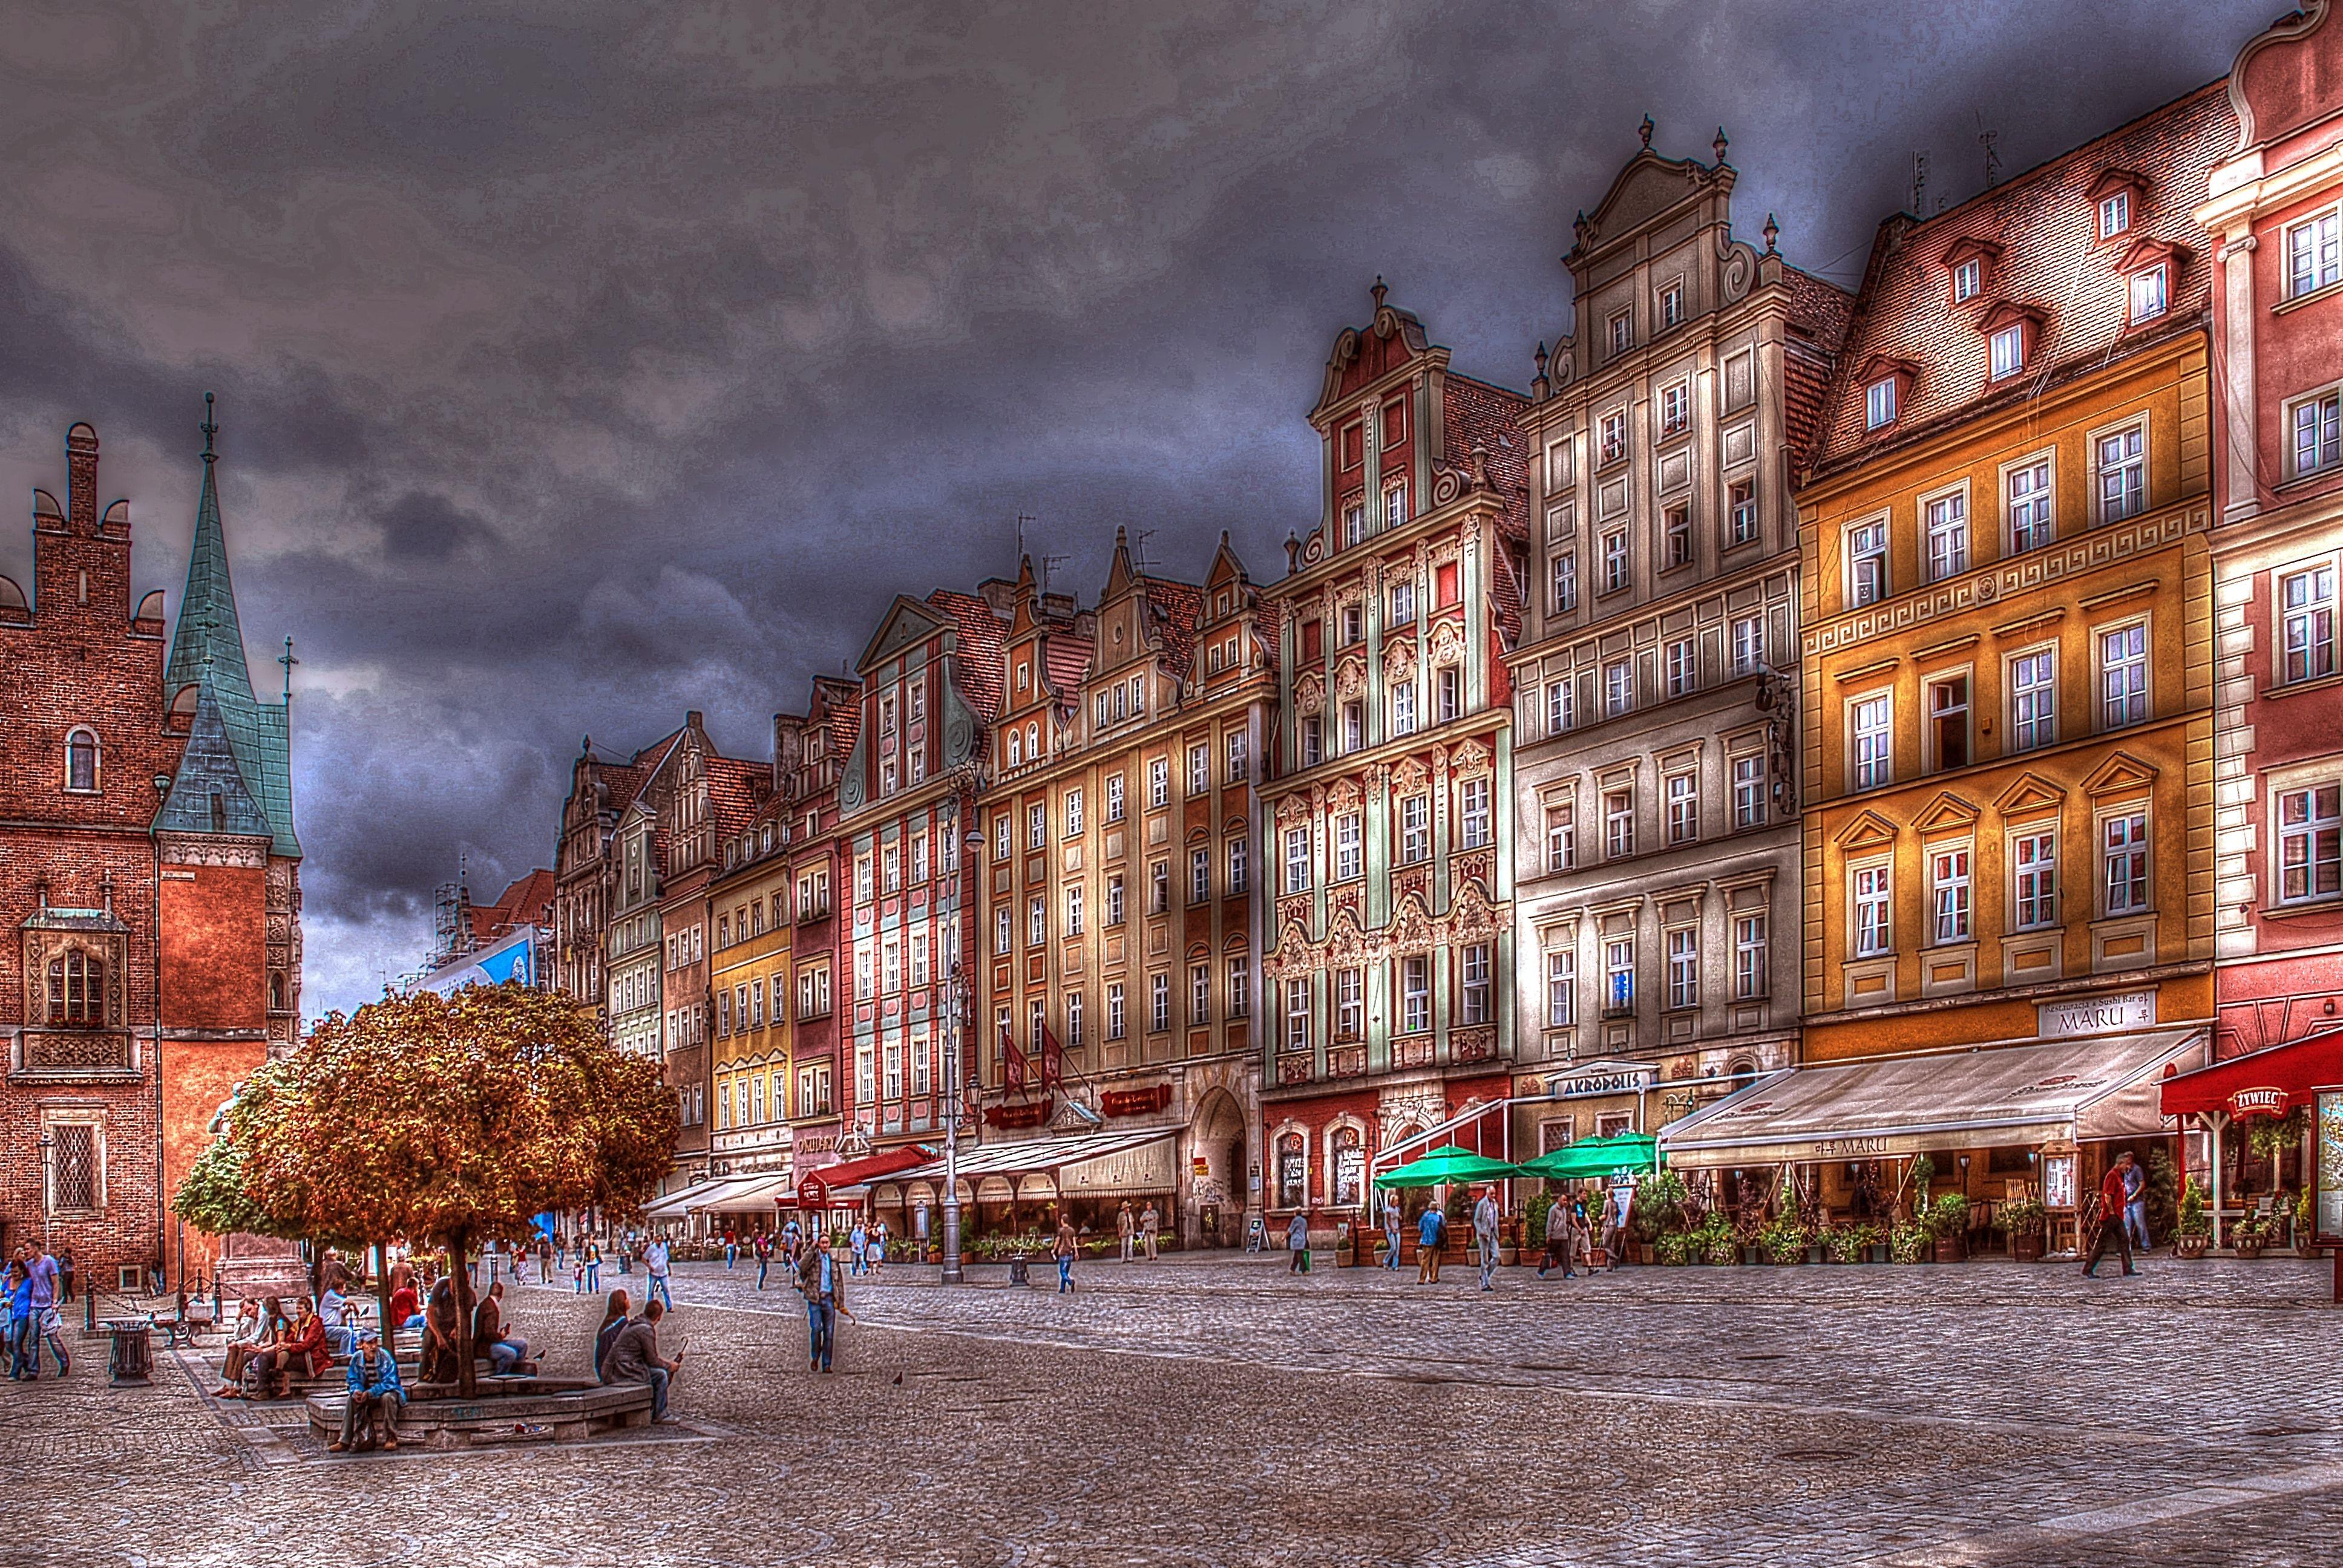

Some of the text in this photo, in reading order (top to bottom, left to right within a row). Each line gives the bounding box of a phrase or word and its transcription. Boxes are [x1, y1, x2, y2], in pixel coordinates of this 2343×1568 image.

[2045, 1002, 2089, 1013] Restauracja
[2099, 996, 2120, 1006] Sushi
[2123, 995, 2135, 1004] Bar
[2059, 1007, 2123, 1034] MARU
[1564, 1073, 1640, 1094] AKROPOLIS
[2237, 1091, 2278, 1108] ŻYWIEC
[1840, 1137, 1887, 1155] MARU
